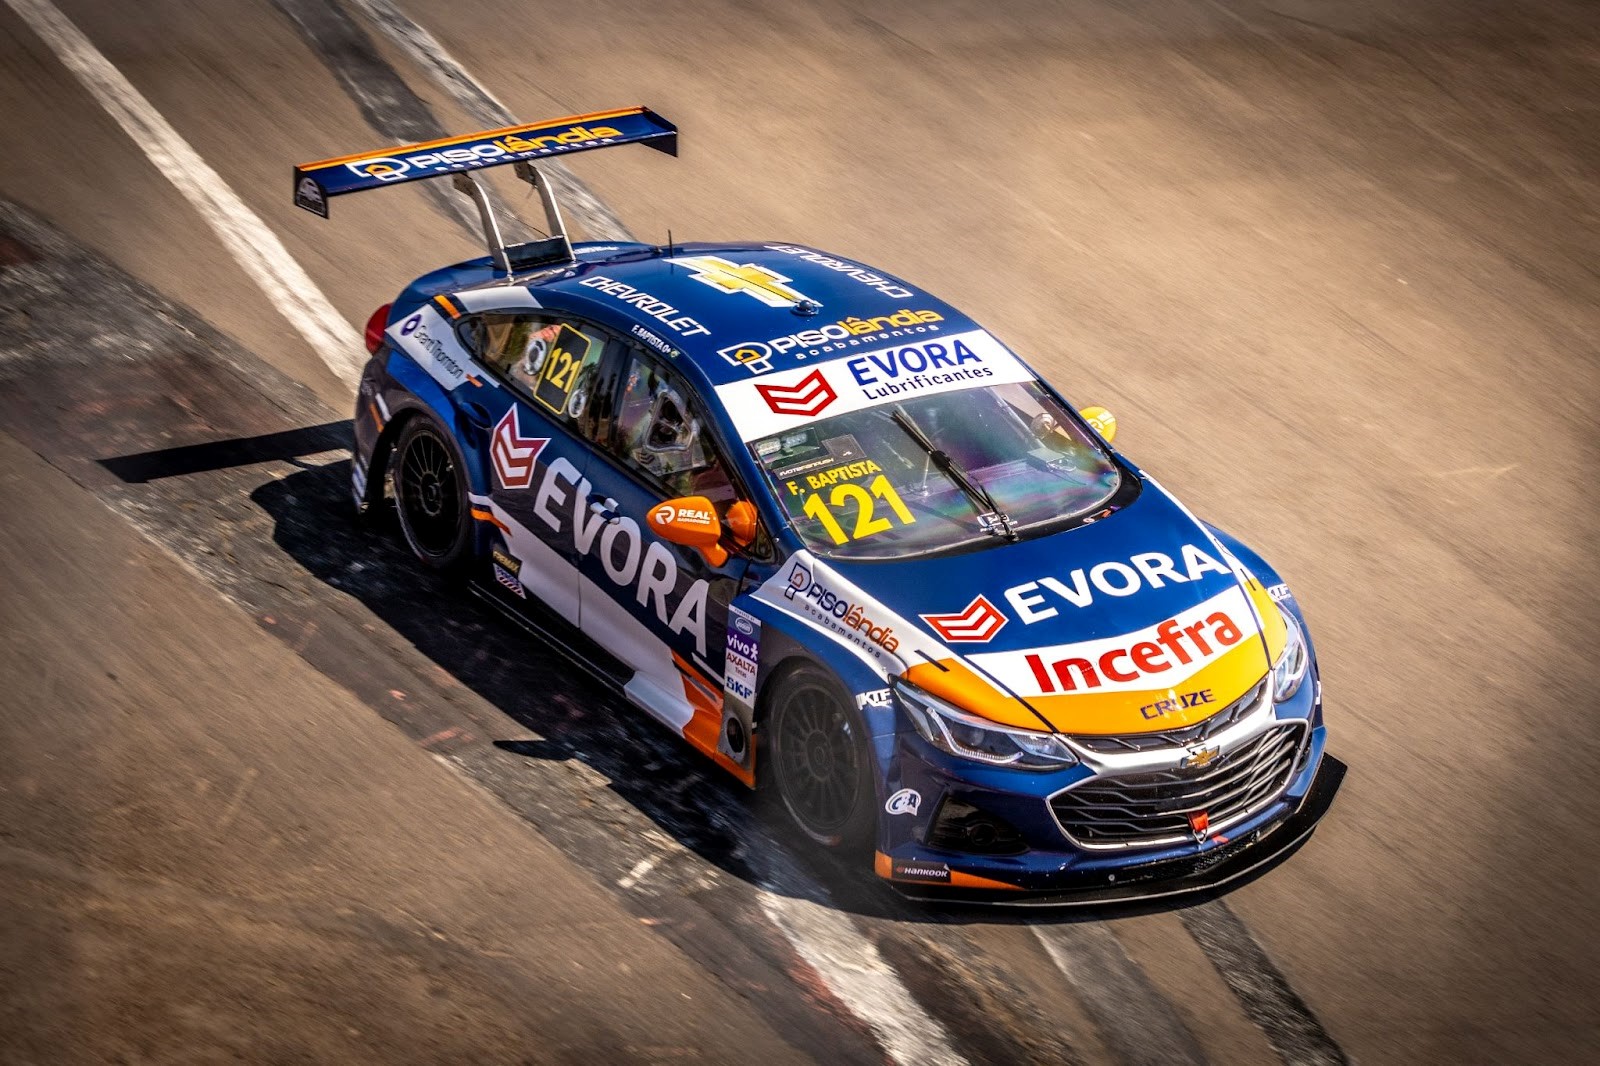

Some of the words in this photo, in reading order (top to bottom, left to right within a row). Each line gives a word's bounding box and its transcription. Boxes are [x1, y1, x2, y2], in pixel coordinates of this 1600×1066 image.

[406, 126, 624, 169] PISOlândia
[764, 245, 914, 298] CHEVROLET
[579, 276, 711, 337] CHEVROLET
[637, 327, 665, 350] BAPTISTA
[767, 308, 944, 355] PISOlândia
[796, 325, 940, 360] acabamentos
[546, 347, 581, 393] 121
[847, 339, 982, 386] EVORA
[862, 367, 993, 400] Lubrificantes
[786, 481, 805, 496] F.
[806, 460, 881, 489] BAPTISTA
[678, 508, 711, 520] REAL
[803, 474, 916, 546] 121
[533, 457, 710, 658] EVORA
[1004, 544, 1232, 625] EVORA
[804, 605, 881, 658] acabamentos
[807, 582, 899, 653] PISOlândia
[726, 652, 756, 676] AXALTA
[727, 634, 749, 656] vivo
[1025, 612, 1243, 693] Incefra
[726, 677, 753, 699] SKF
[1140, 689, 1216, 720] CRUZE
